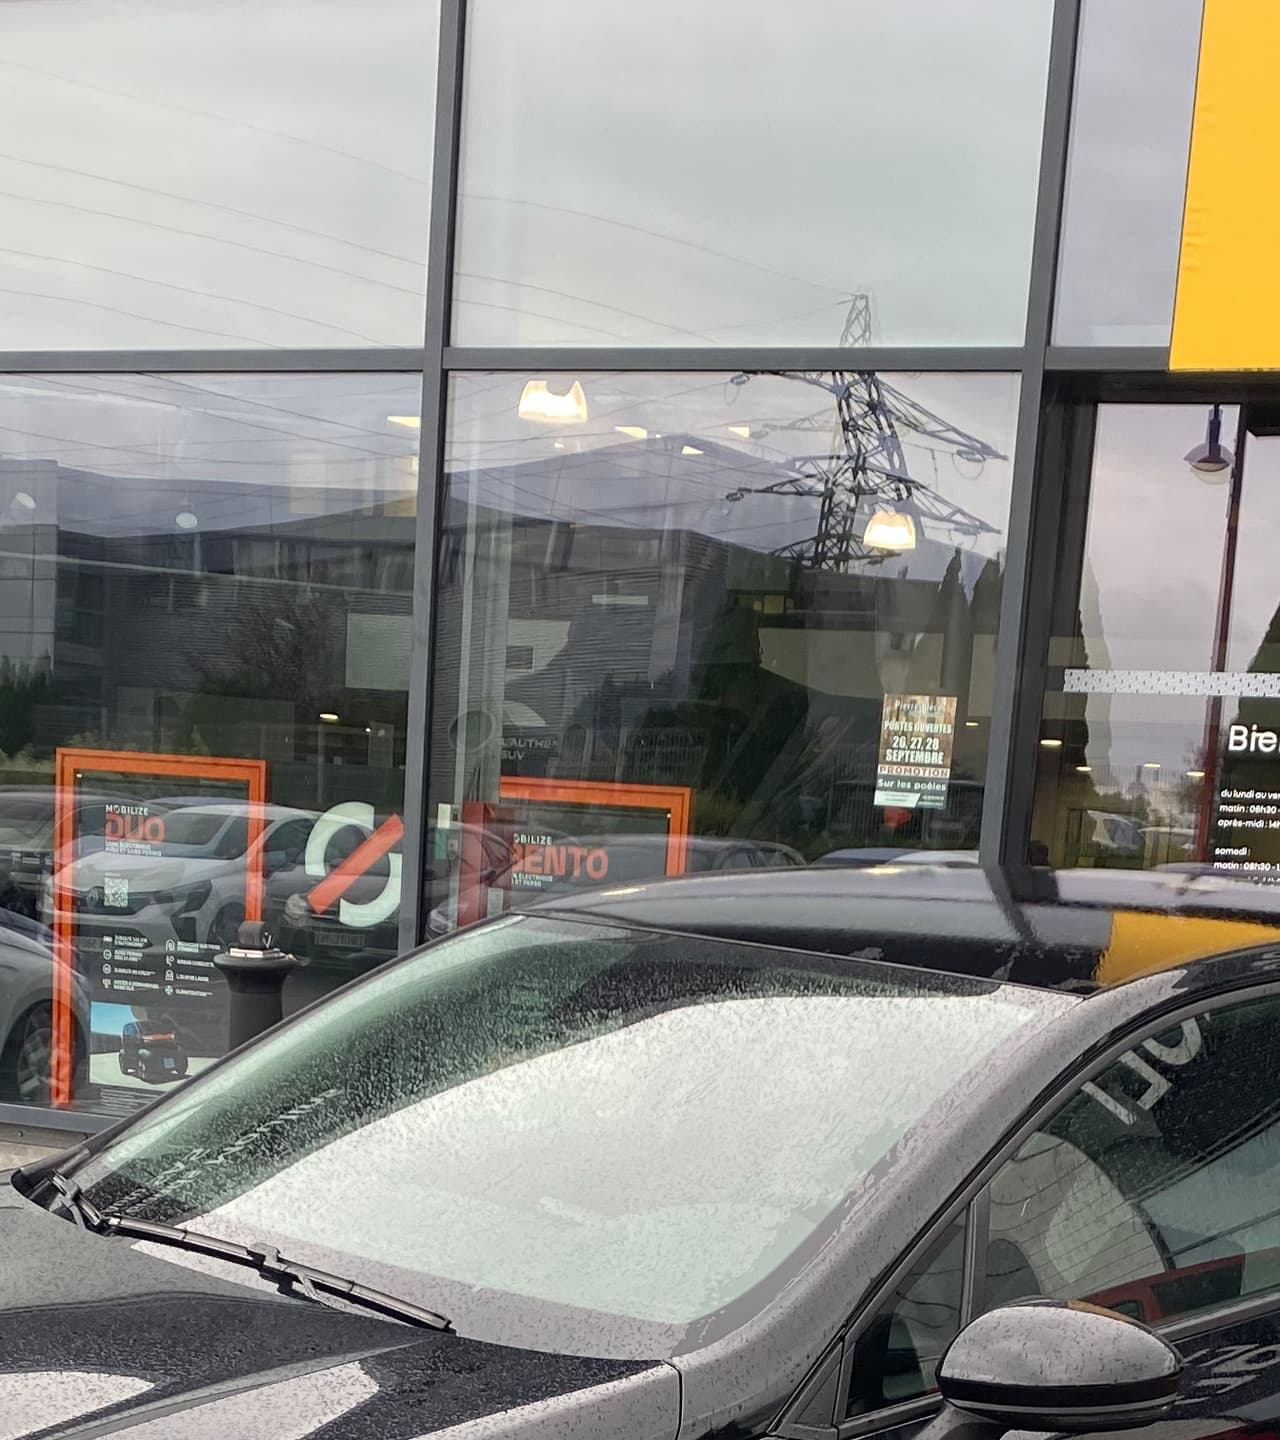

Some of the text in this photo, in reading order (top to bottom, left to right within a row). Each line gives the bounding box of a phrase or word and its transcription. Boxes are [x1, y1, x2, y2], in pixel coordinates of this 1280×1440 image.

[884, 721, 952, 734] PORTES OUVERTES
[885, 750, 945, 765] SEPTEMBRE
[879, 766, 949, 778] PROMOTION
[877, 778, 894, 787] Sur
[897, 779, 911, 789] les
[1221, 789, 1232, 798] du
[1233, 789, 1254, 799] lundi
[105, 804, 149, 816] MOBILIZE
[1219, 804, 1245, 813] matin
[1249, 805, 1277, 814] 08h30
[105, 813, 165, 844] DUO
[1218, 818, 1265, 828] après-midi
[513, 833, 552, 845] OBILIZE
[1215, 847, 1247, 856] samedi
[1214, 862, 1239, 870] matin
[1243, 862, 1271, 871] 08h30
